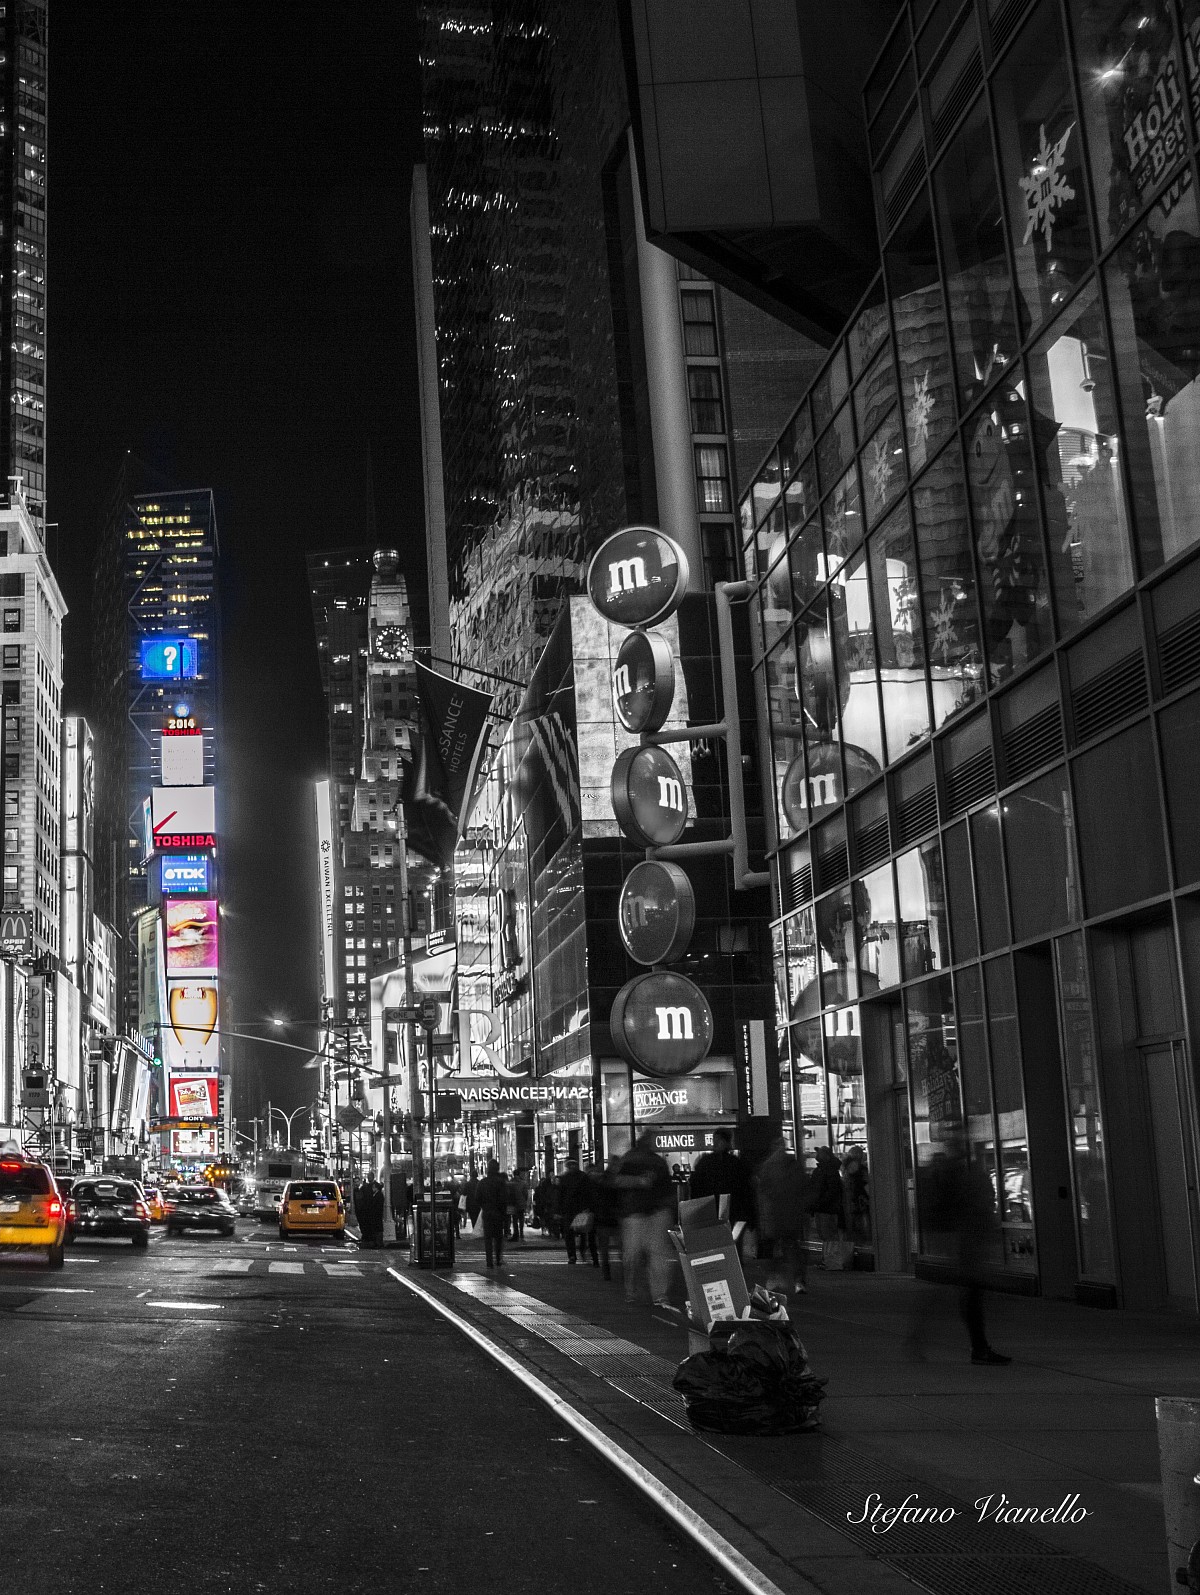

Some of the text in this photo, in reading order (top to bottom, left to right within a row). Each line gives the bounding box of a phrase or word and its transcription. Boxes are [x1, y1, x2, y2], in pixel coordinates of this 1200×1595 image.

[608, 555, 647, 593] m
[168, 718, 195, 729] 2014
[162, 728, 202, 736] TOSHIBA
[449, 732, 468, 773] HOTELS
[658, 775, 683, 812] m
[154, 835, 215, 847] TOSHIBA
[175, 869, 205, 879] TDK
[655, 1006, 693, 1040] m
[635, 1089, 688, 1107] EXCHANGE
[655, 1134, 695, 1148] CHANGE
